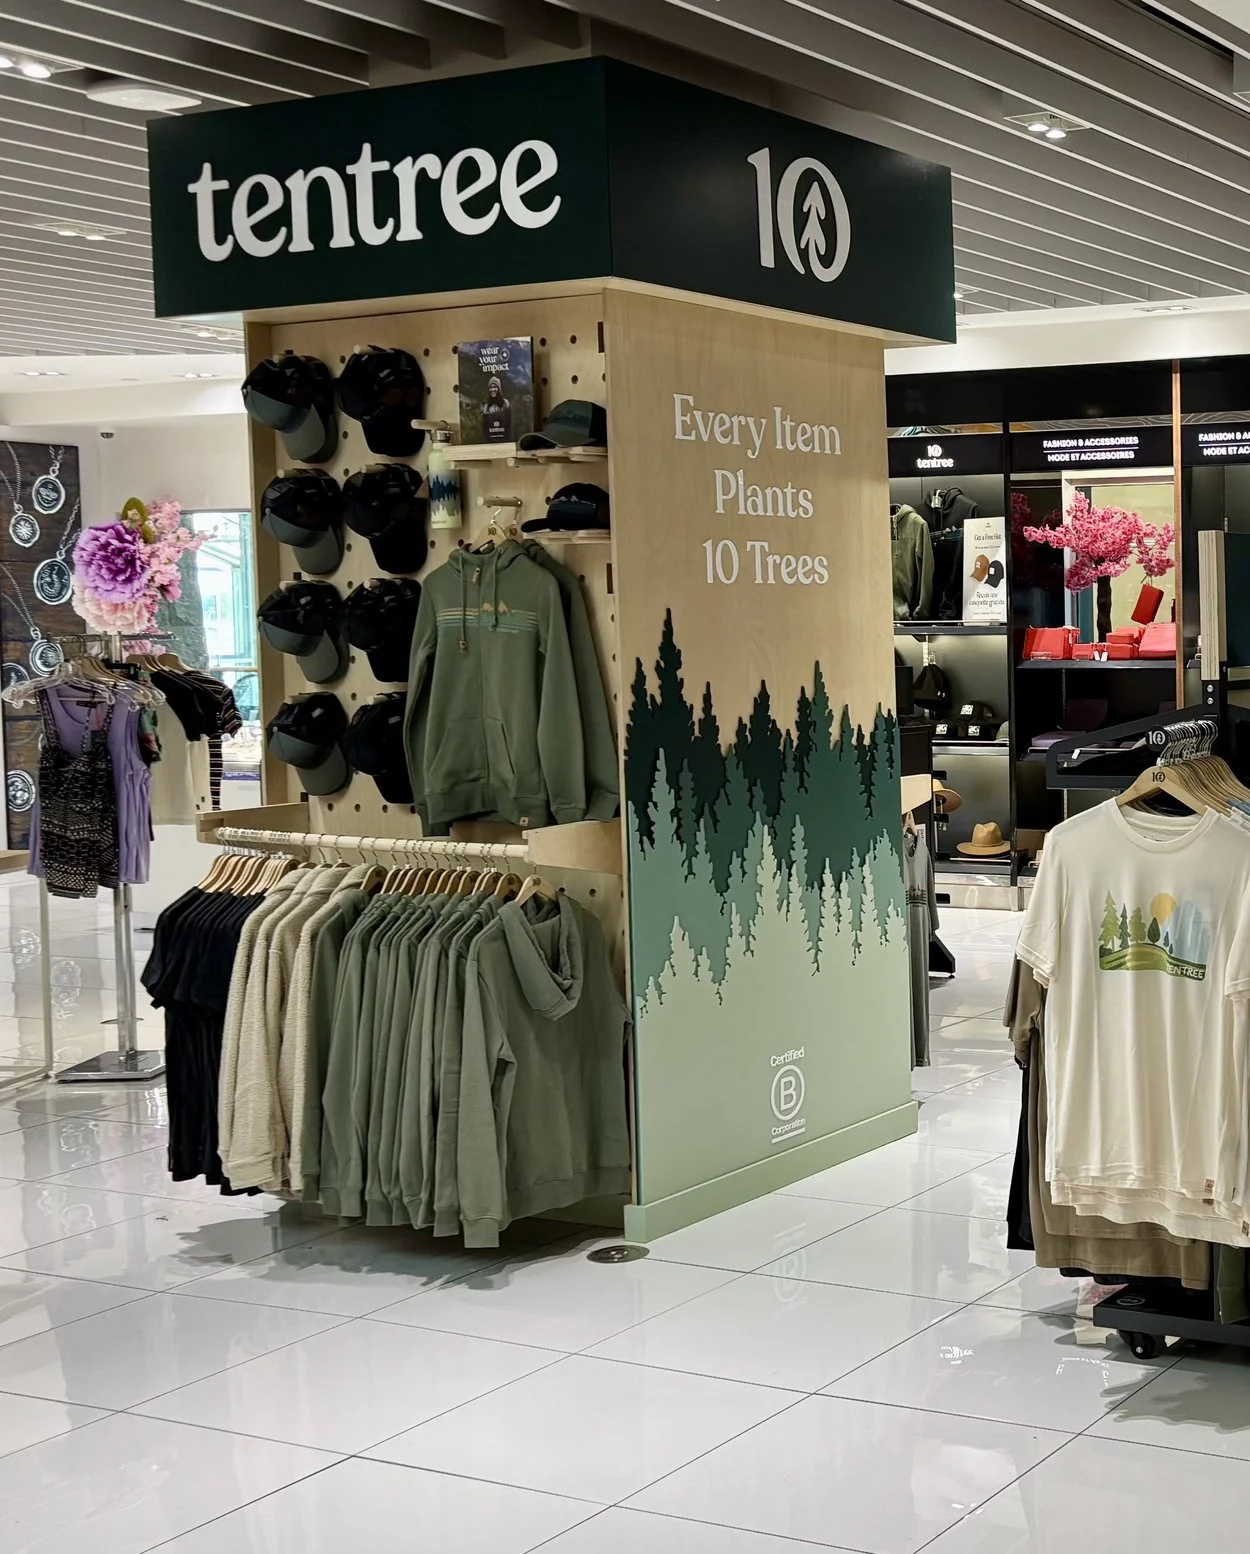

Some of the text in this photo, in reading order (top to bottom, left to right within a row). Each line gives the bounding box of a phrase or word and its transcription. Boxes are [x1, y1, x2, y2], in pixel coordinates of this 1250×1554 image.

[188, 140, 561, 262] tentree
[747, 147, 852, 282] 10
[481, 347, 499, 355] wear
[479, 356, 497, 366] your
[482, 363, 509, 374] impact
[673, 393, 842, 458] Every Item
[1043, 439, 1077, 448] FASHION
[1084, 436, 1139, 446] ACCESSORIES
[1199, 432, 1235, 442] FASHION
[1047, 451, 1135, 462] MODE ET ACCESSOIRES
[1203, 447, 1227, 456] MODE
[1228, 446, 1238, 455] ET
[916, 458, 954, 468] tentree
[714, 469, 814, 519] Plants
[703, 539, 829, 585] 10 Trees
[1147, 730, 1166, 745] 10
[770, 1045, 805, 1067] Certified
[771, 1118, 806, 1136] Corporation
